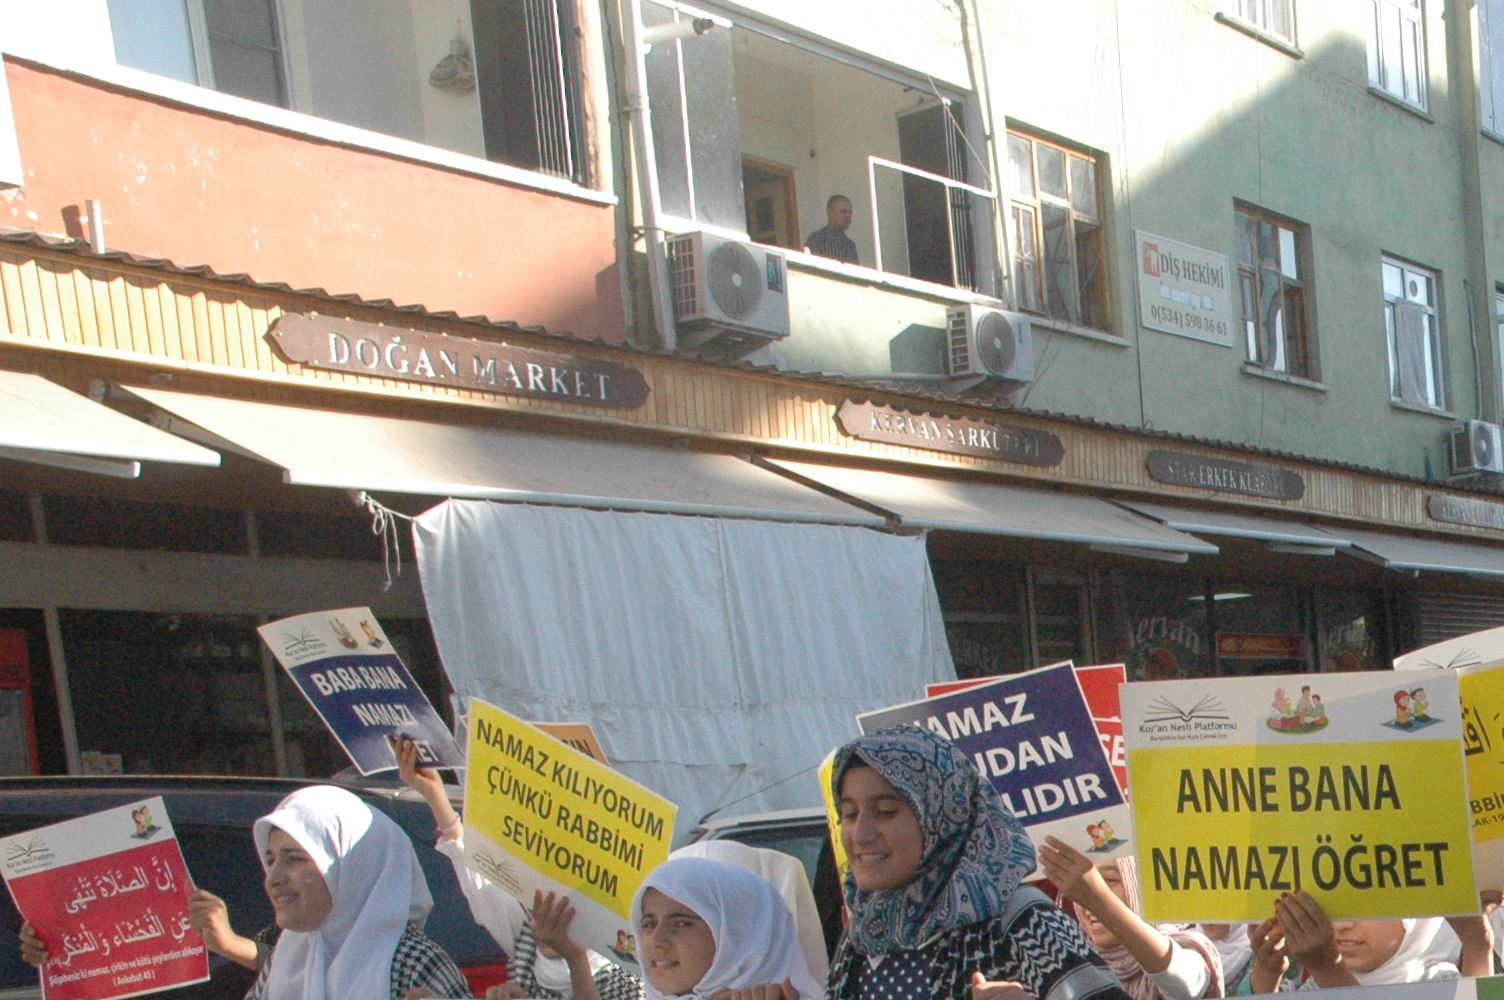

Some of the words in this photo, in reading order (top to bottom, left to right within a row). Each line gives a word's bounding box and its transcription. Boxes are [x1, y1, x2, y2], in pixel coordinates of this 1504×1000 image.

[1160, 252, 1180, 281] DİŞ
[1182, 260, 1225, 289] HEKİMİ
[328, 332, 459, 379] DOĞAN
[472, 355, 610, 400] MARKET
[869, 411, 942, 440] KERVAN
[1200, 465, 1237, 489] ERKEK
[311, 667, 365, 697] BABA
[358, 666, 408, 690] BANA
[352, 703, 419, 727] NAMAZI
[913, 692, 1035, 741] AMAZ
[1194, 721, 1237, 731] Platformu
[476, 718, 550, 777] NAMAZ
[551, 760, 665, 842] KILIYORUM
[1176, 766, 1280, 814] ANNE
[1288, 764, 1402, 813] BANA
[487, 765, 554, 820] ÇÜNKÜ
[556, 804, 645, 871] RABBİMİ
[502, 814, 619, 898] SEVİYORUM
[1151, 845, 1301, 892] NAMAZI
[1311, 833, 1450, 892] ÖĞRET
